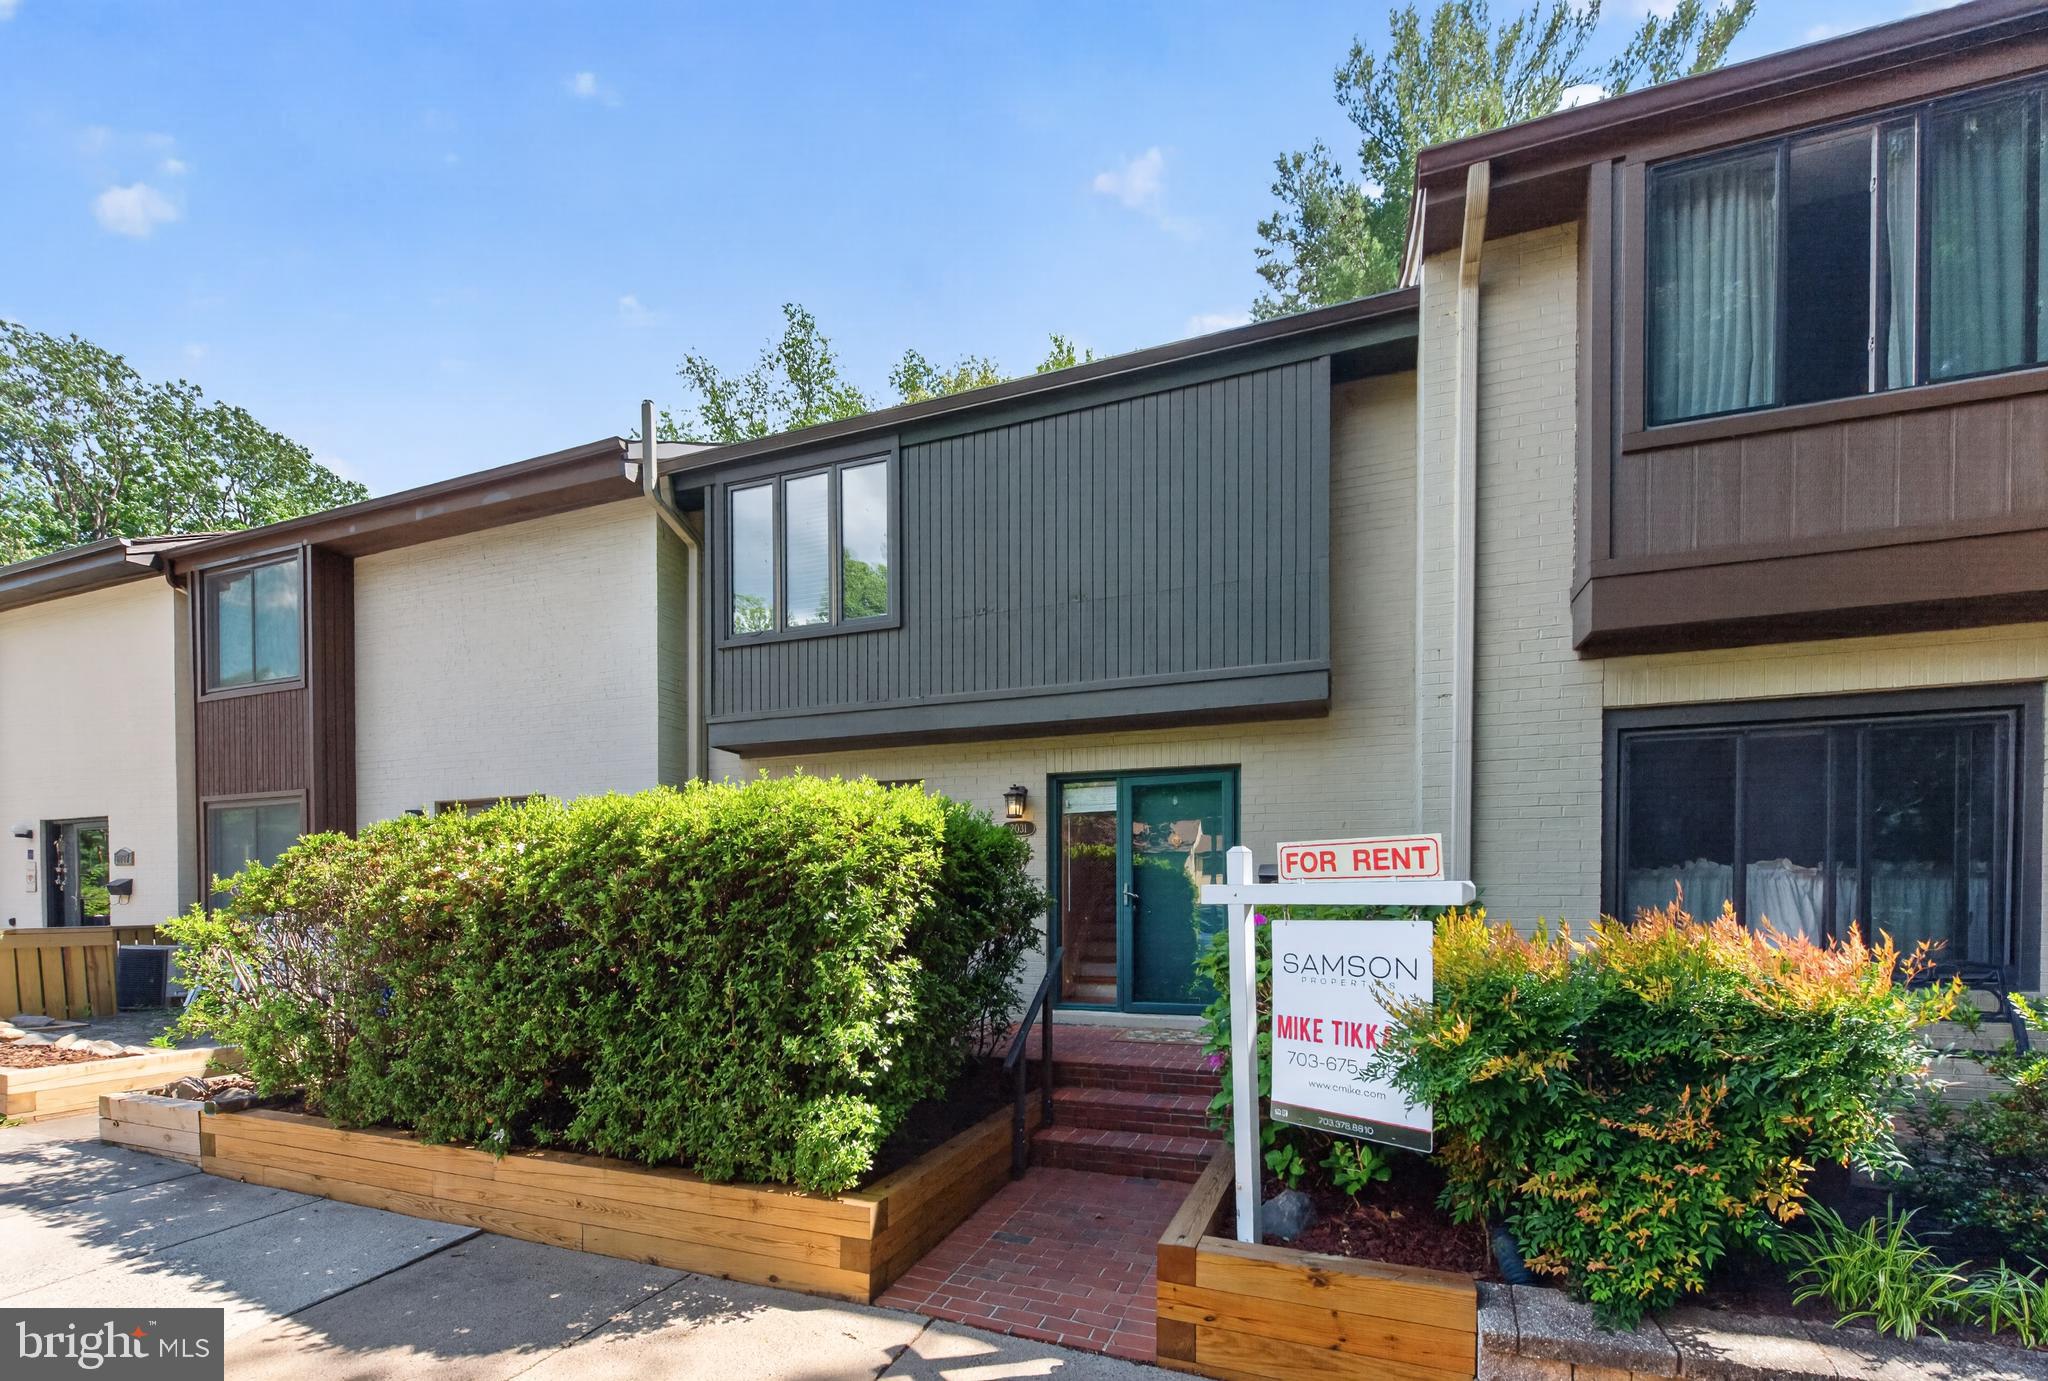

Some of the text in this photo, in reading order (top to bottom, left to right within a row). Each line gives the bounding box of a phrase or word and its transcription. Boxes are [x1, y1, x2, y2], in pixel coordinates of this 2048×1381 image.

[1286, 846, 1432, 874] FOR RENT
[1282, 952, 1418, 981] SAMSON
[1277, 1015, 1324, 1044] MIKE
[1308, 1080, 1386, 1100] www.cmike.com
